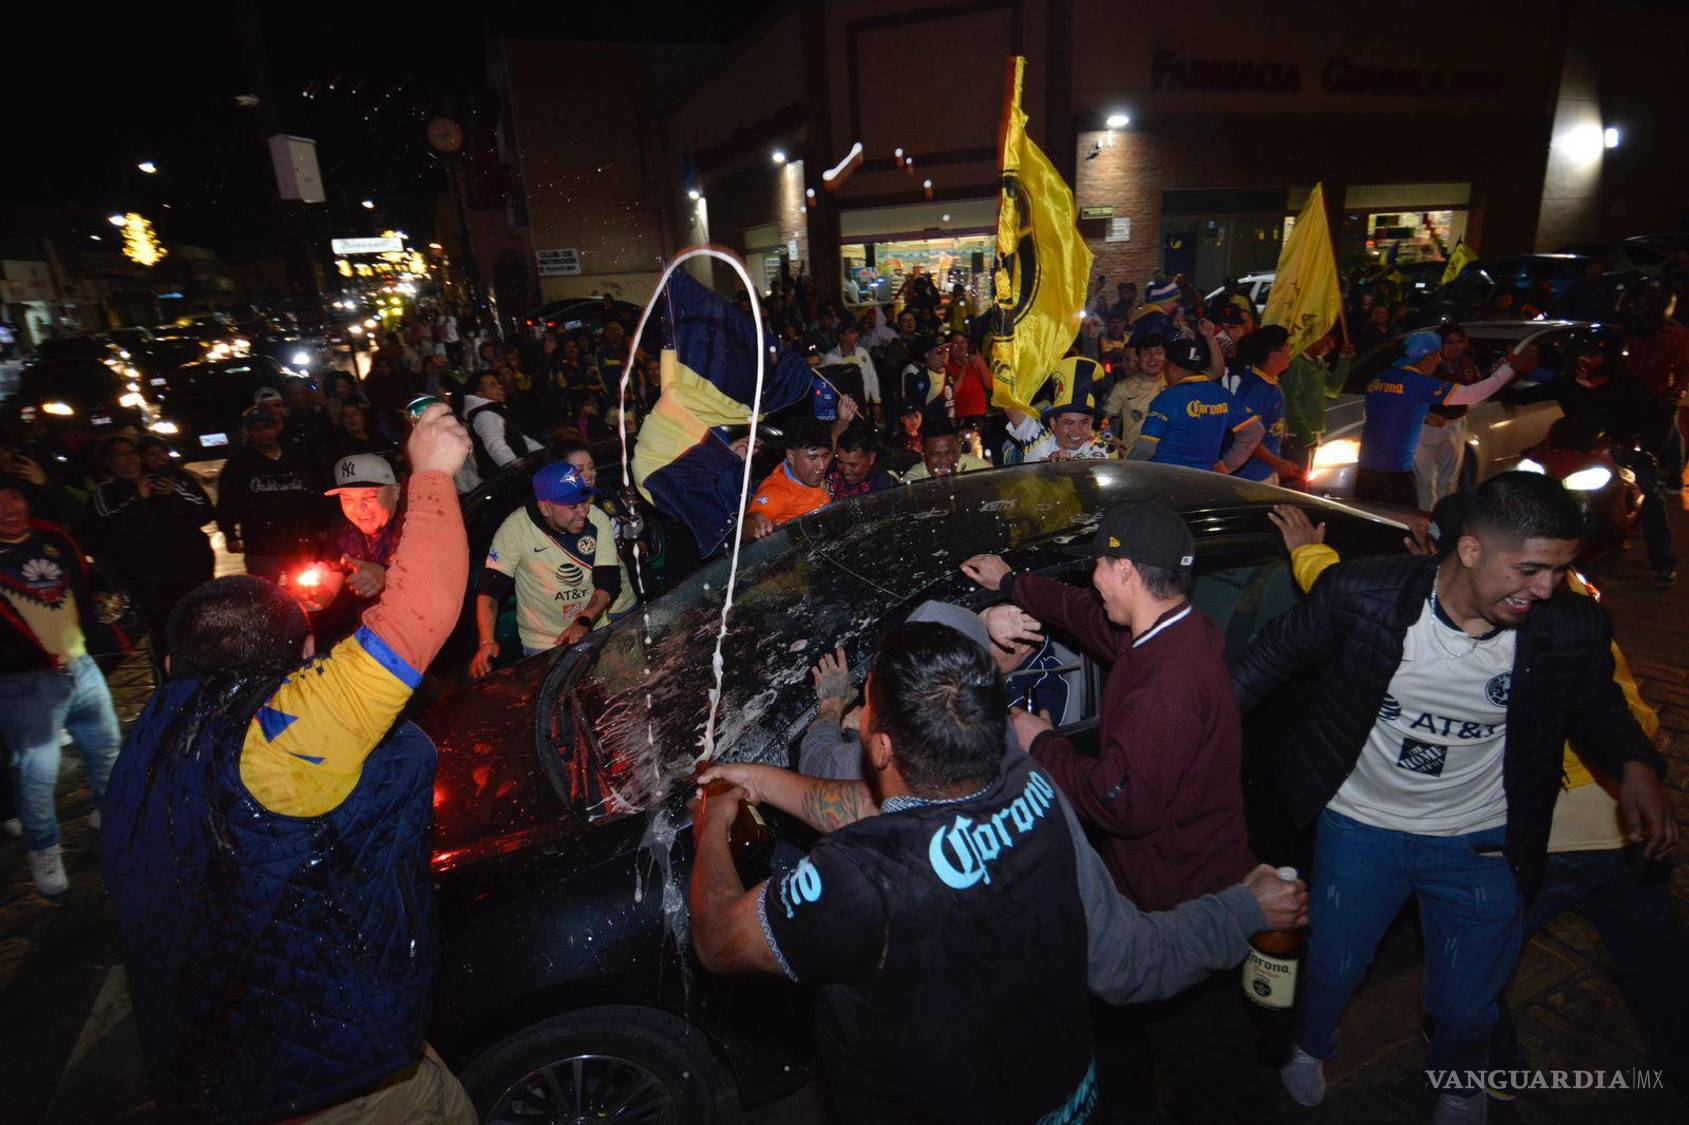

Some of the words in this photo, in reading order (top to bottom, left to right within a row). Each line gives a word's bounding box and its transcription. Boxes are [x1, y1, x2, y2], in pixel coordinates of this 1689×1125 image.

[1187, 400, 1228, 419] Corona
[555, 588, 589, 601] AT&T
[929, 771, 1055, 889] Corona
